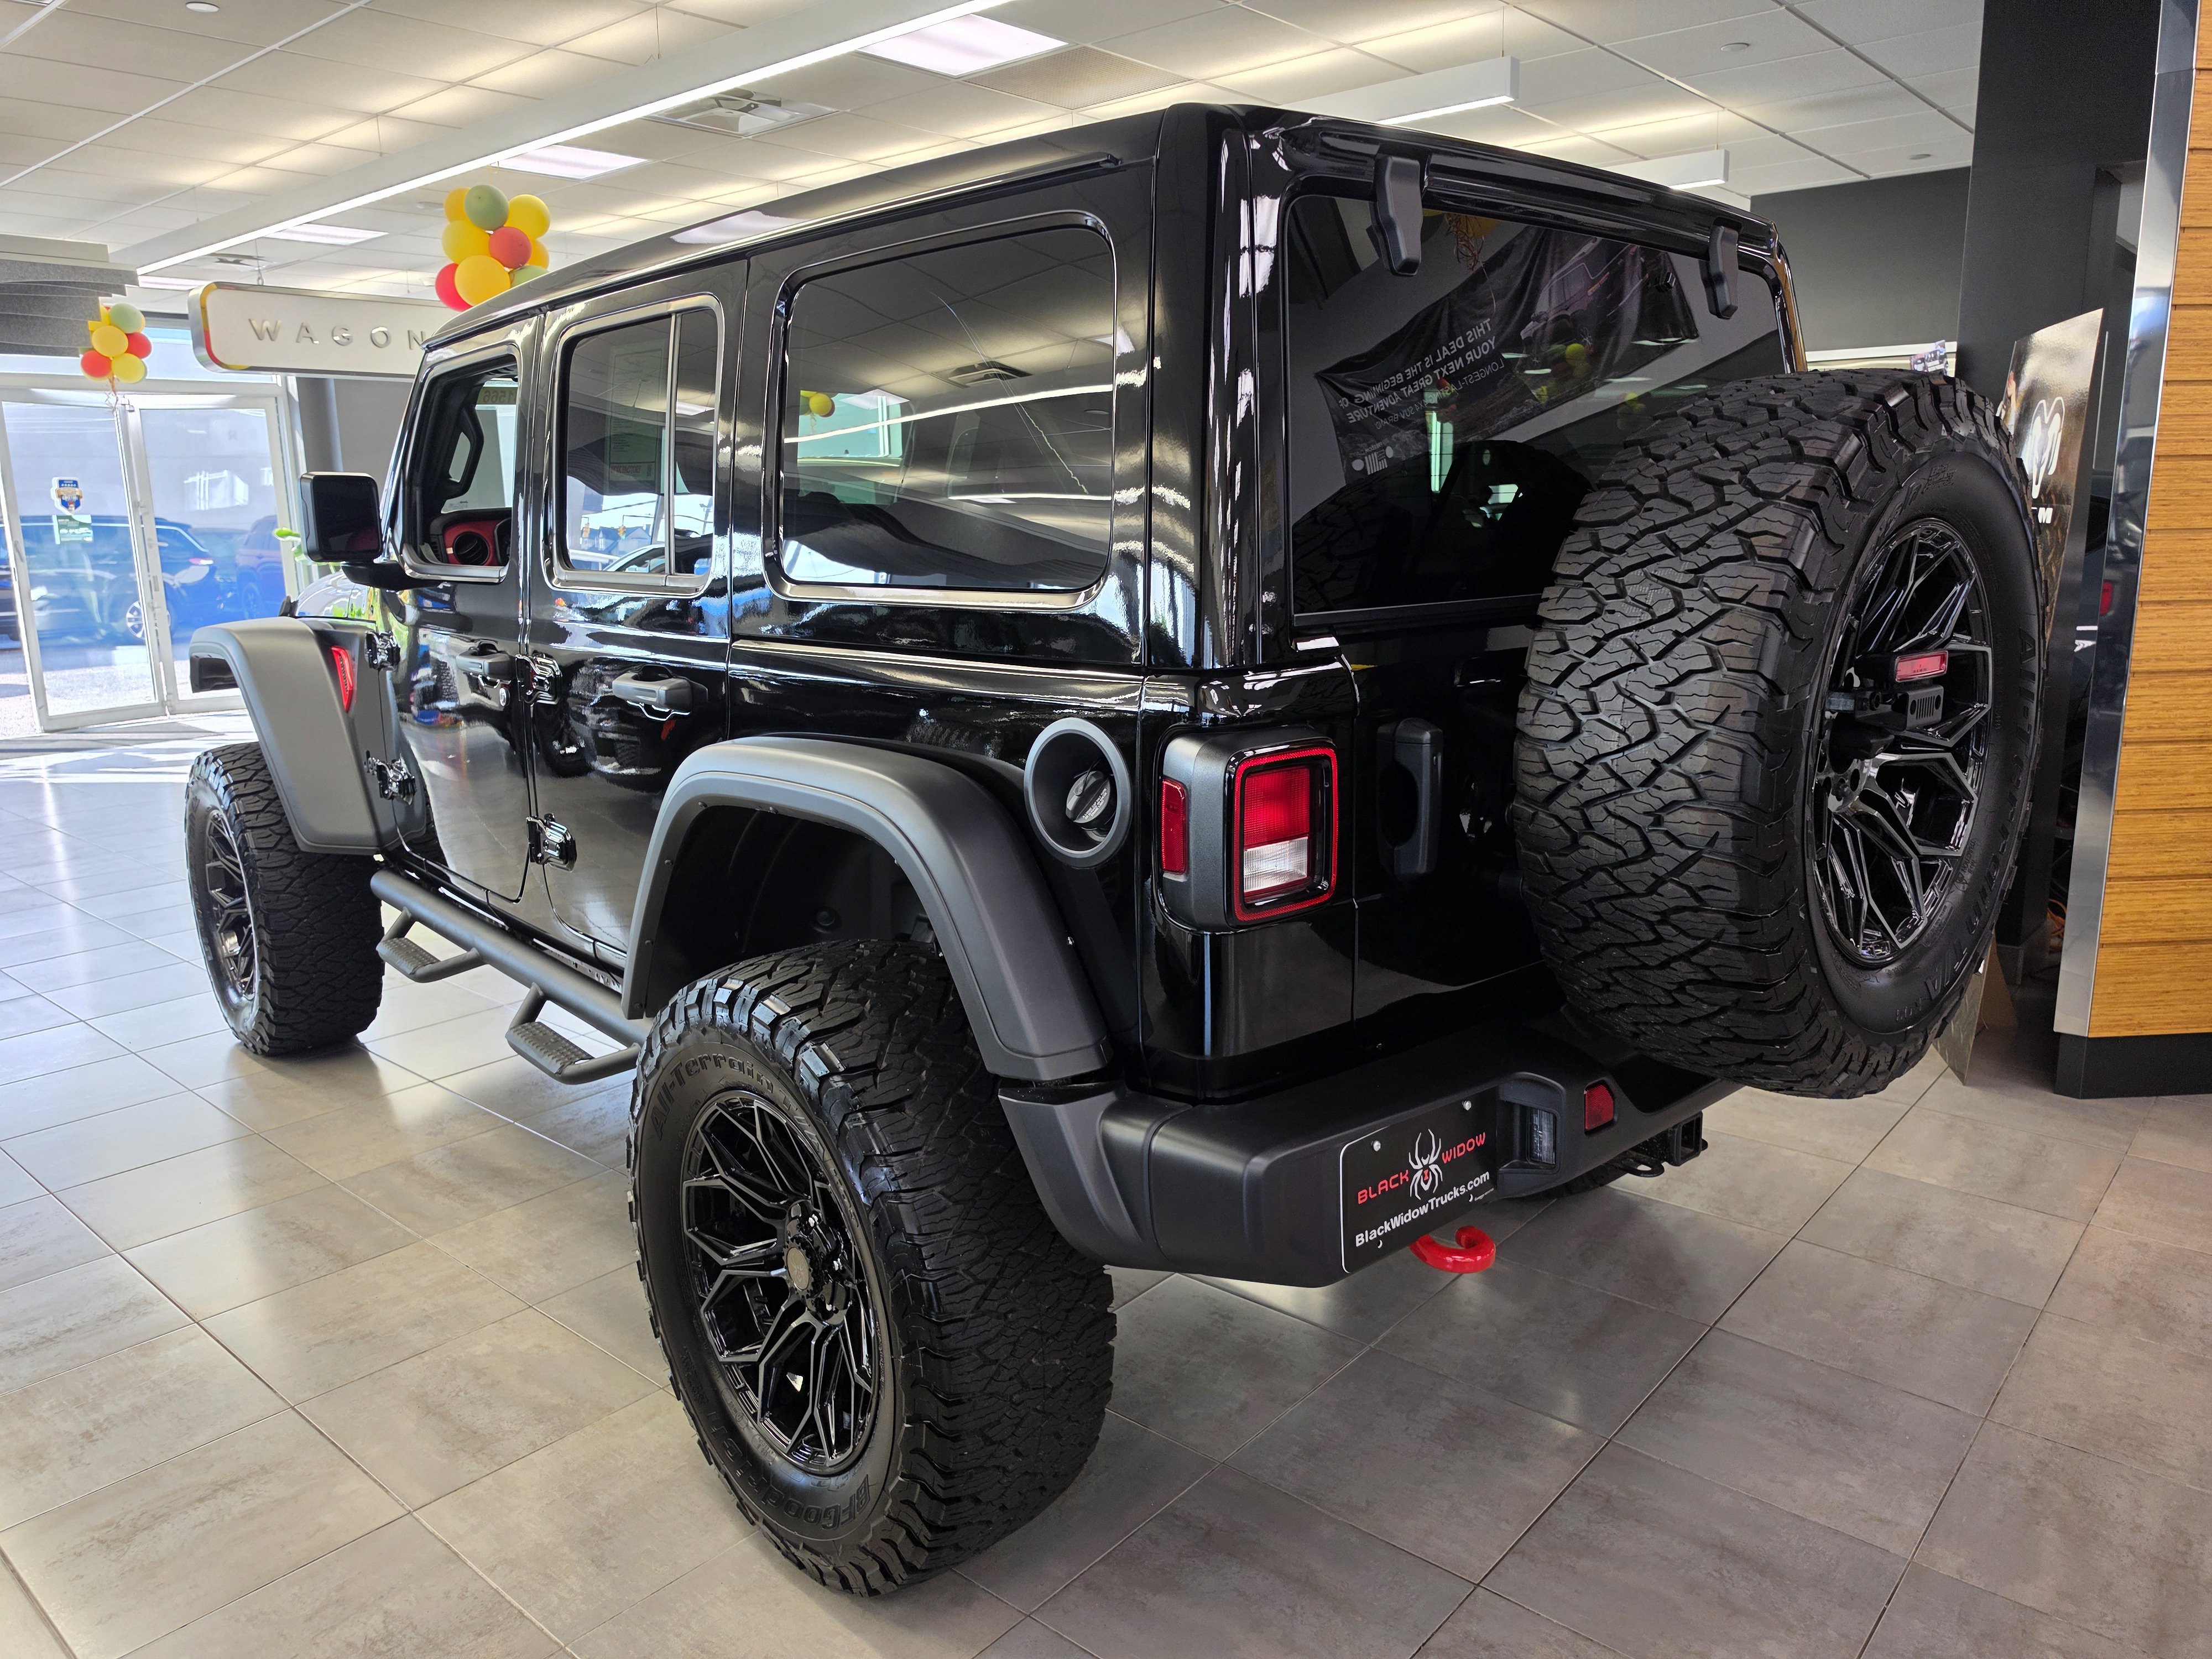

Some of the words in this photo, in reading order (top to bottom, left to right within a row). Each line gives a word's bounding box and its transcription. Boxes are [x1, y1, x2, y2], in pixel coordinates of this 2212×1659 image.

[651, 1052, 774, 1141] All-Terrain
[1355, 1171, 1489, 1247] BlackWidowTrucks.com
[1358, 1169, 1409, 1204] BLACK
[1442, 1132, 1486, 1164] WIDOW
[707, 1411, 871, 1530] BFGoodrich
